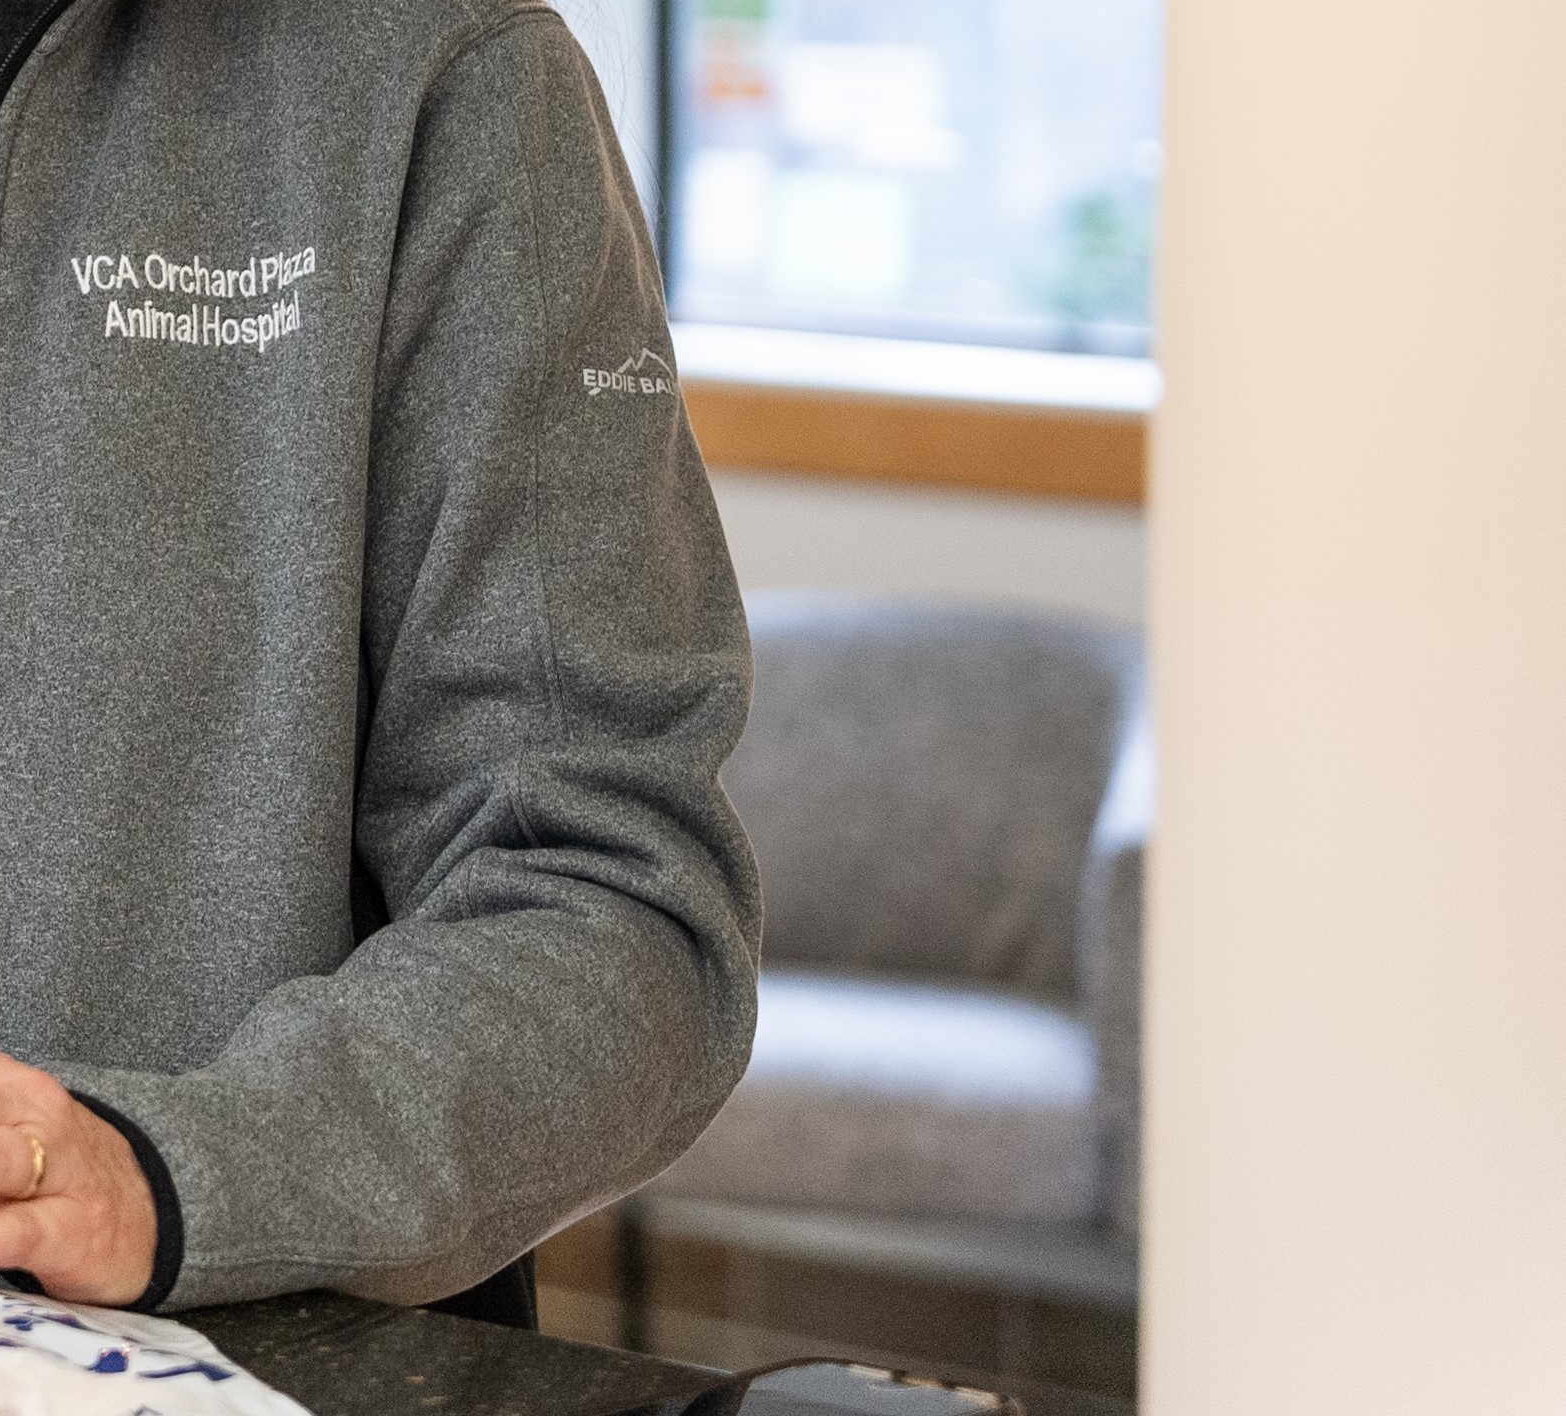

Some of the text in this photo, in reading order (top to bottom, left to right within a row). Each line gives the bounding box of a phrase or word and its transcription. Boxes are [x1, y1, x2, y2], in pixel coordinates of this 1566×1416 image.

[70, 245, 316, 299] VCA Orchard Plaza
[104, 289, 301, 353] Animal Hospital
[582, 368, 637, 393] EDDIE
